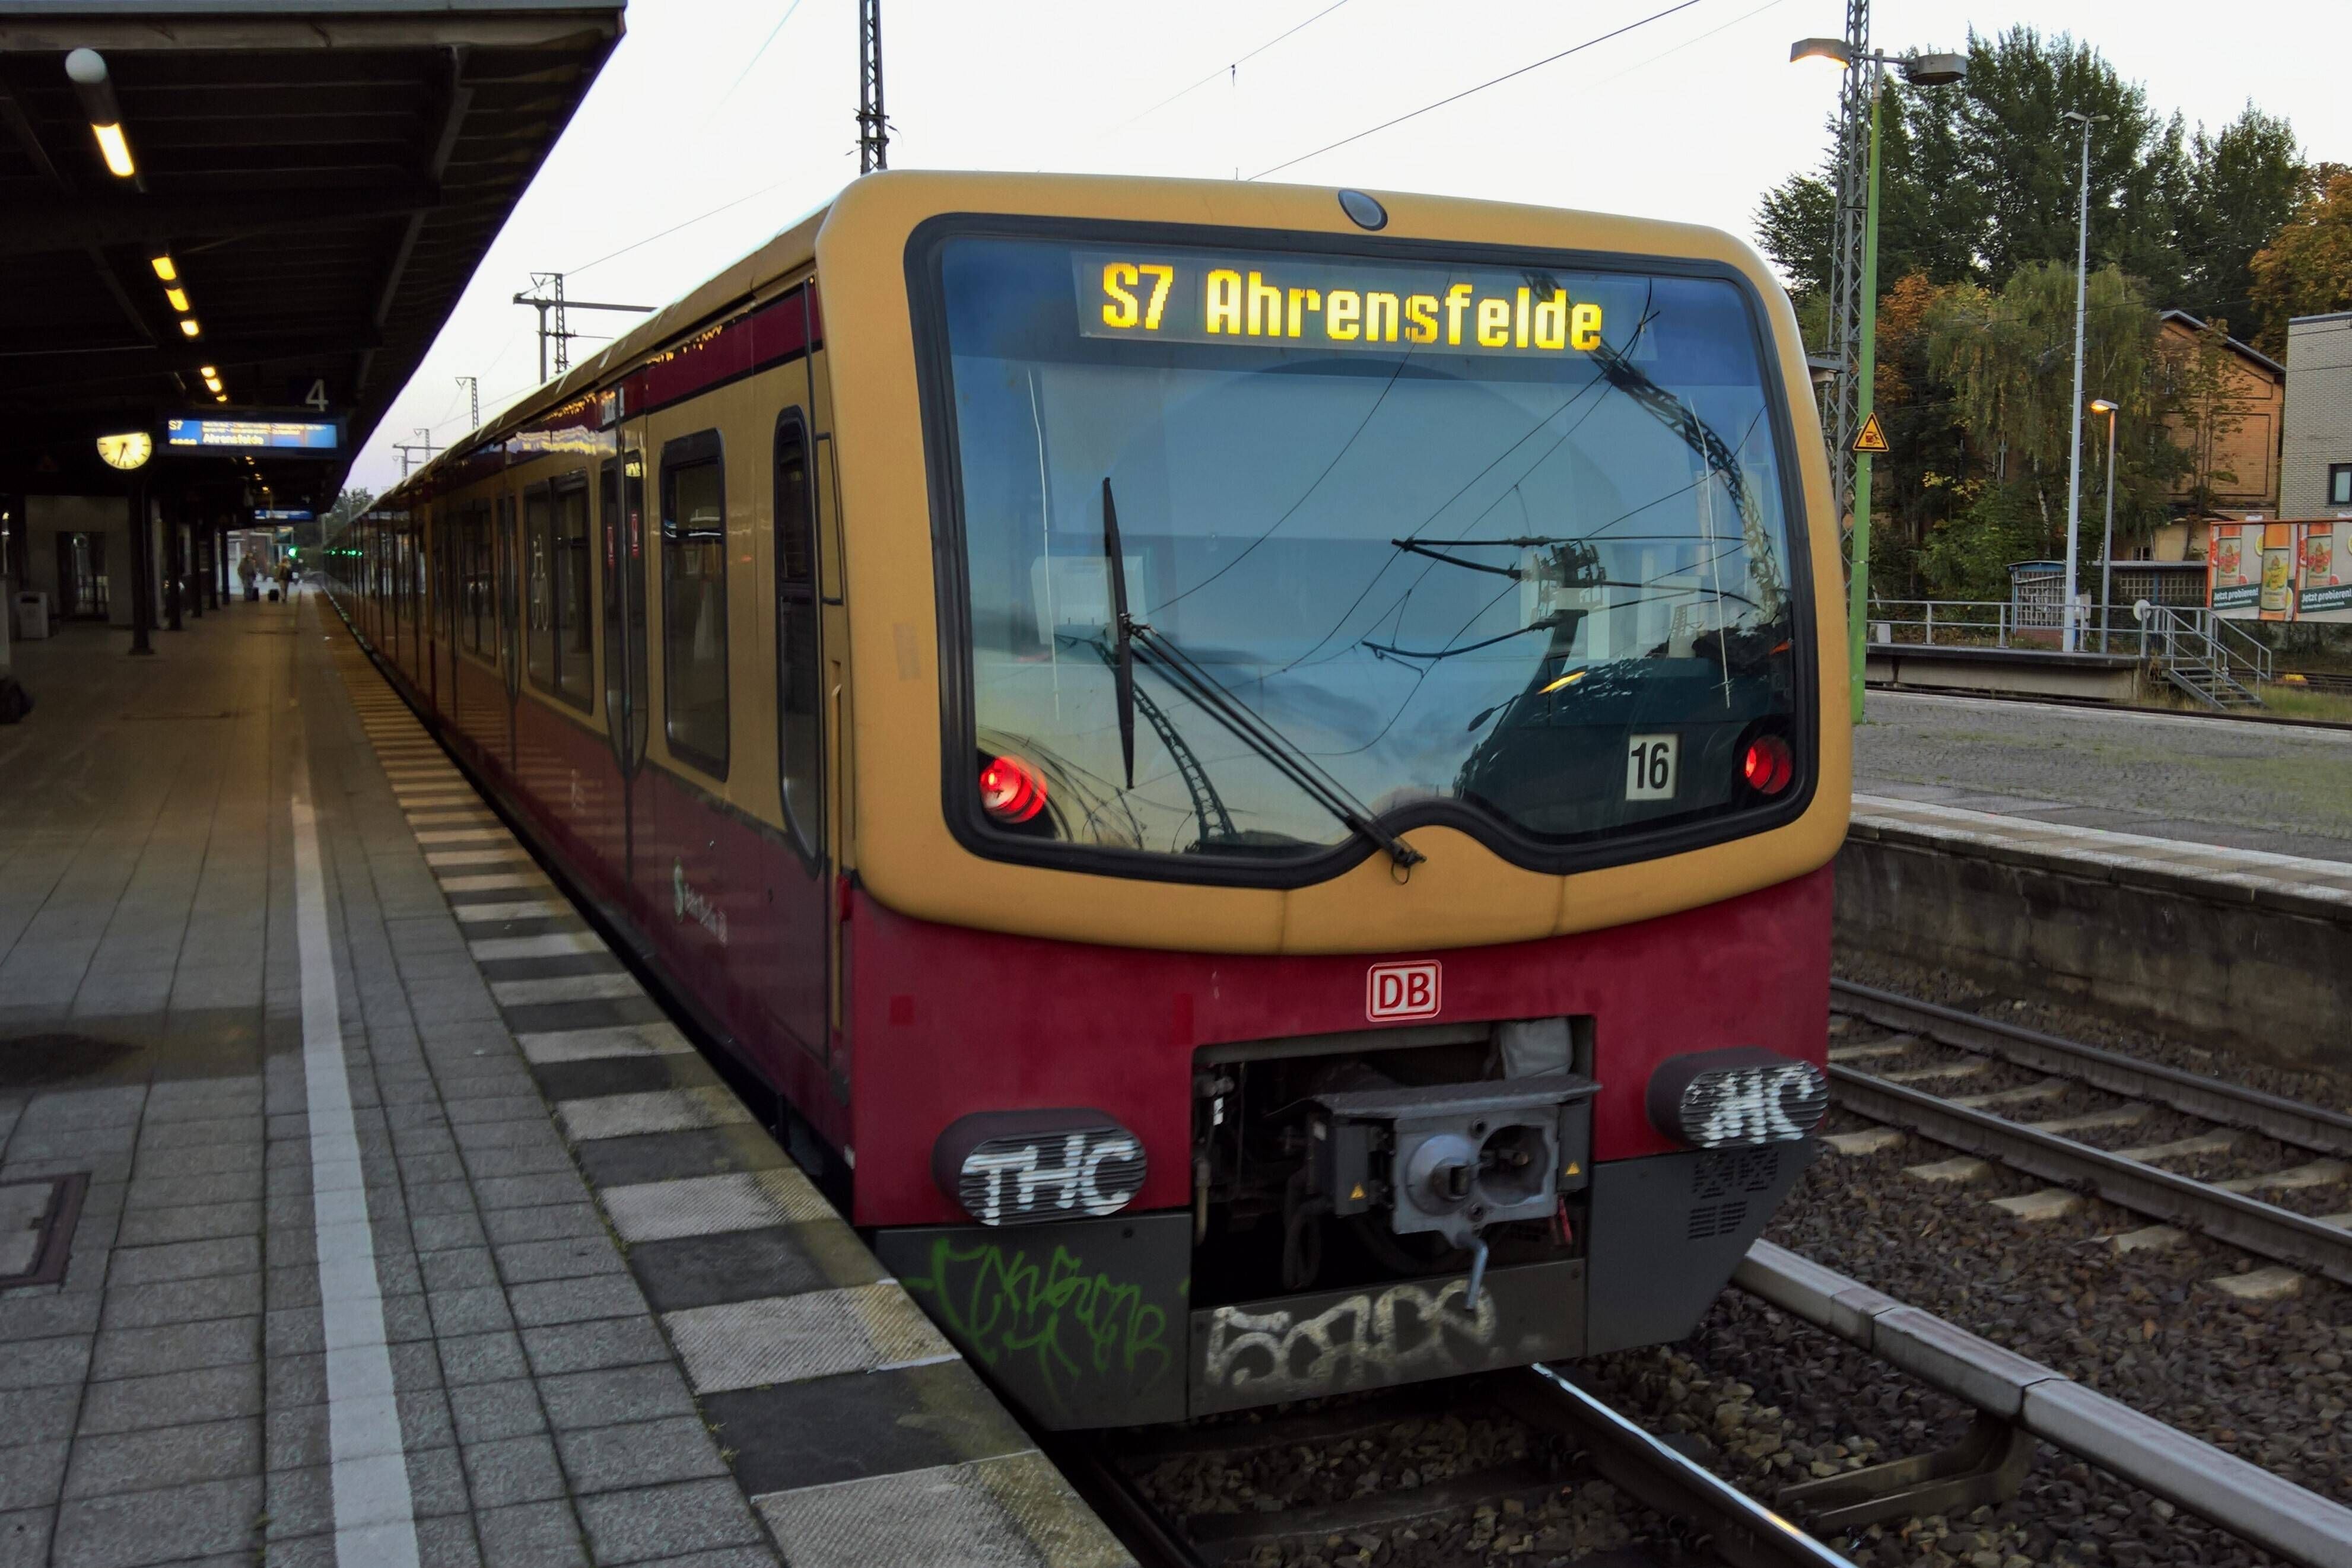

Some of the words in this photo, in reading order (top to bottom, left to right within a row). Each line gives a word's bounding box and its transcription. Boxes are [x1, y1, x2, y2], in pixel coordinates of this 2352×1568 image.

[1102, 262, 1174, 330] S7
[1206, 268, 1603, 351] Ahrensfelde
[305, 379, 329, 412] 4
[168, 419, 183, 430] S7
[2302, 593, 2317, 603] Jetzt
[2318, 588, 2352, 603] probieren!
[1631, 742, 1669, 789] 16
[1380, 972, 1430, 1009] DB
[961, 1134, 1136, 1226] THC
